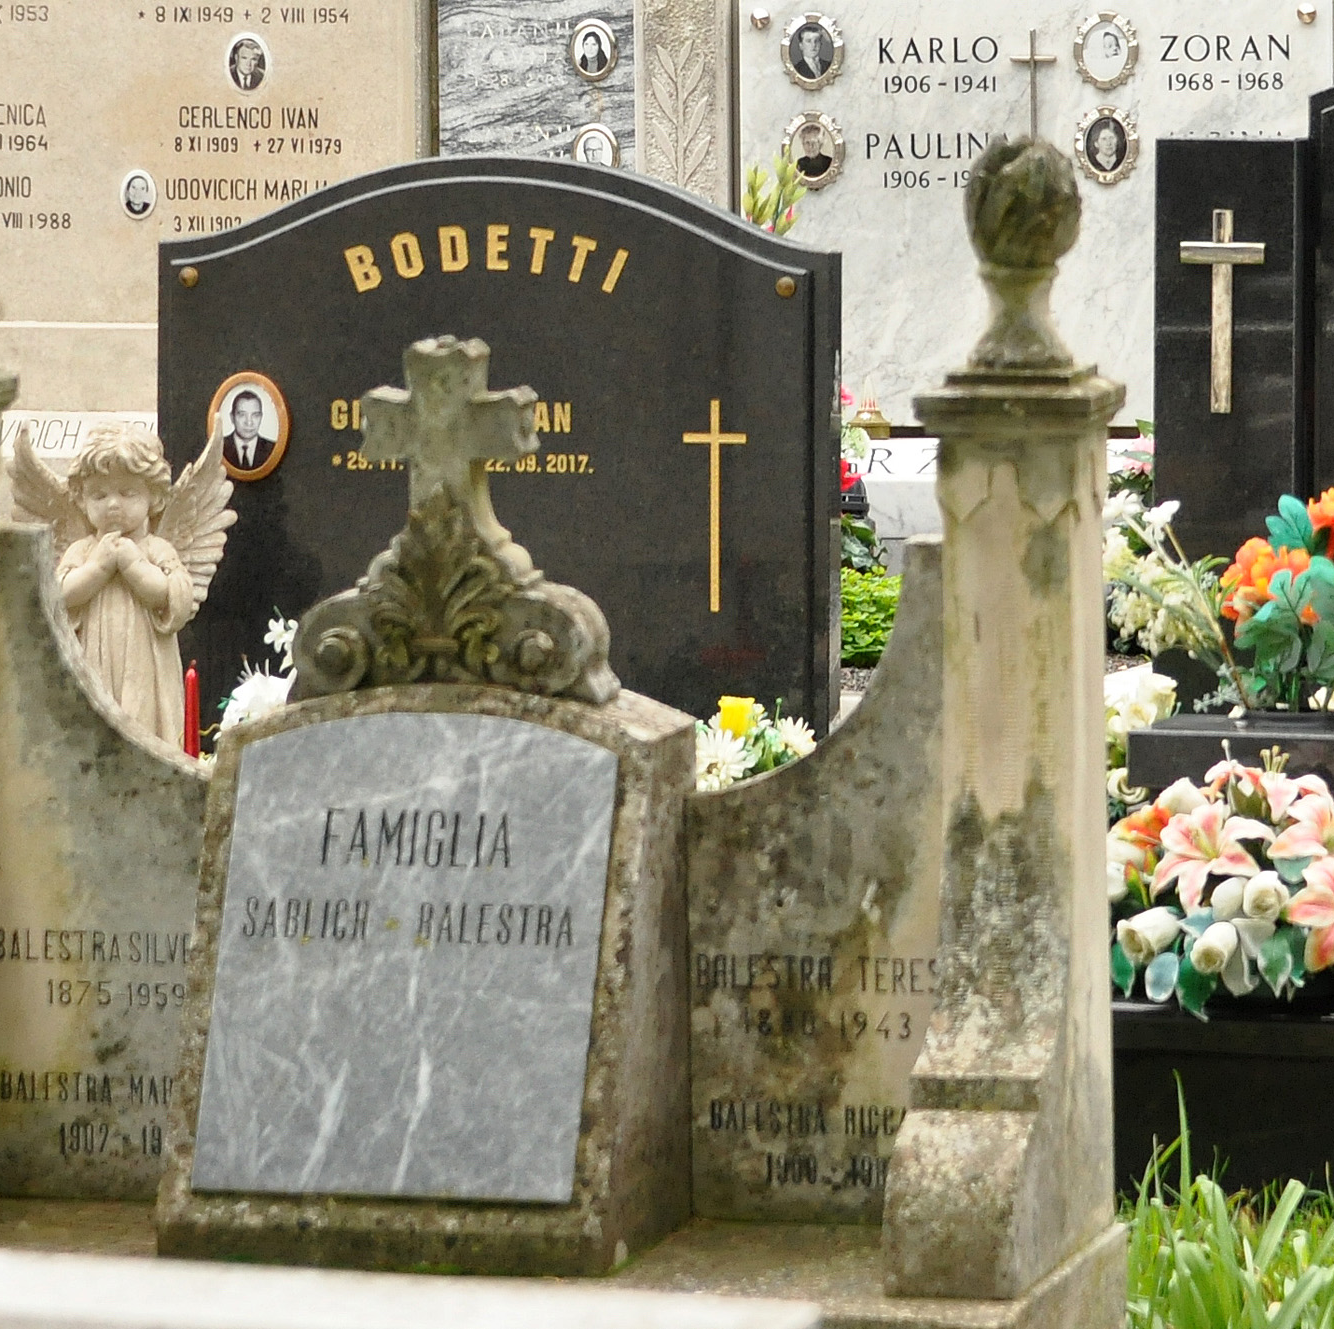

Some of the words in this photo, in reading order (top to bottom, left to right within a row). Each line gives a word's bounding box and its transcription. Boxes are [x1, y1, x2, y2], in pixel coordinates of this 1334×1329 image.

[10, 5, 49, 22] 1953
[155, 6, 166, 23] 8
[198, 6, 234, 22] 1949
[261, 7, 271, 23] 2
[281, 7, 305, 23] VIII
[313, 7, 349, 23] 1954
[878, 36, 998, 64] KARLO
[1159, 34, 1291, 62] ZORAN
[884, 75, 931, 93] 1906
[954, 76, 997, 93] 1941
[1167, 73, 1214, 91] 1968
[1237, 72, 1284, 90] 1968
[179, 106, 272, 129] CERLENCO
[281, 106, 319, 129] IVAN
[8, 134, 48, 151] 1964
[174, 137, 183, 152] 8
[188, 136, 201, 152] XI
[207, 137, 239, 153] 1909
[267, 138, 285, 153] 27
[291, 138, 304, 153] VI
[309, 138, 342, 155] 1979
[866, 132, 1010, 159] PAULIN
[165, 178, 257, 200] UDOVICICH
[884, 171, 931, 188] 1906
[2, 212, 23, 229] VIII
[29, 212, 71, 230] 1988
[174, 216, 182, 232] 3
[188, 216, 205, 232] XII
[343, 223, 630, 294] BODETTI
[546, 454, 594, 474] 2017.
[321, 808, 511, 869] FAMIGLIA
[242, 896, 370, 940] SABLICH
[417, 902, 574, 948] BALESTRA
[696, 953, 833, 992] BALESTRA
[840, 1011, 912, 1041] 1943
